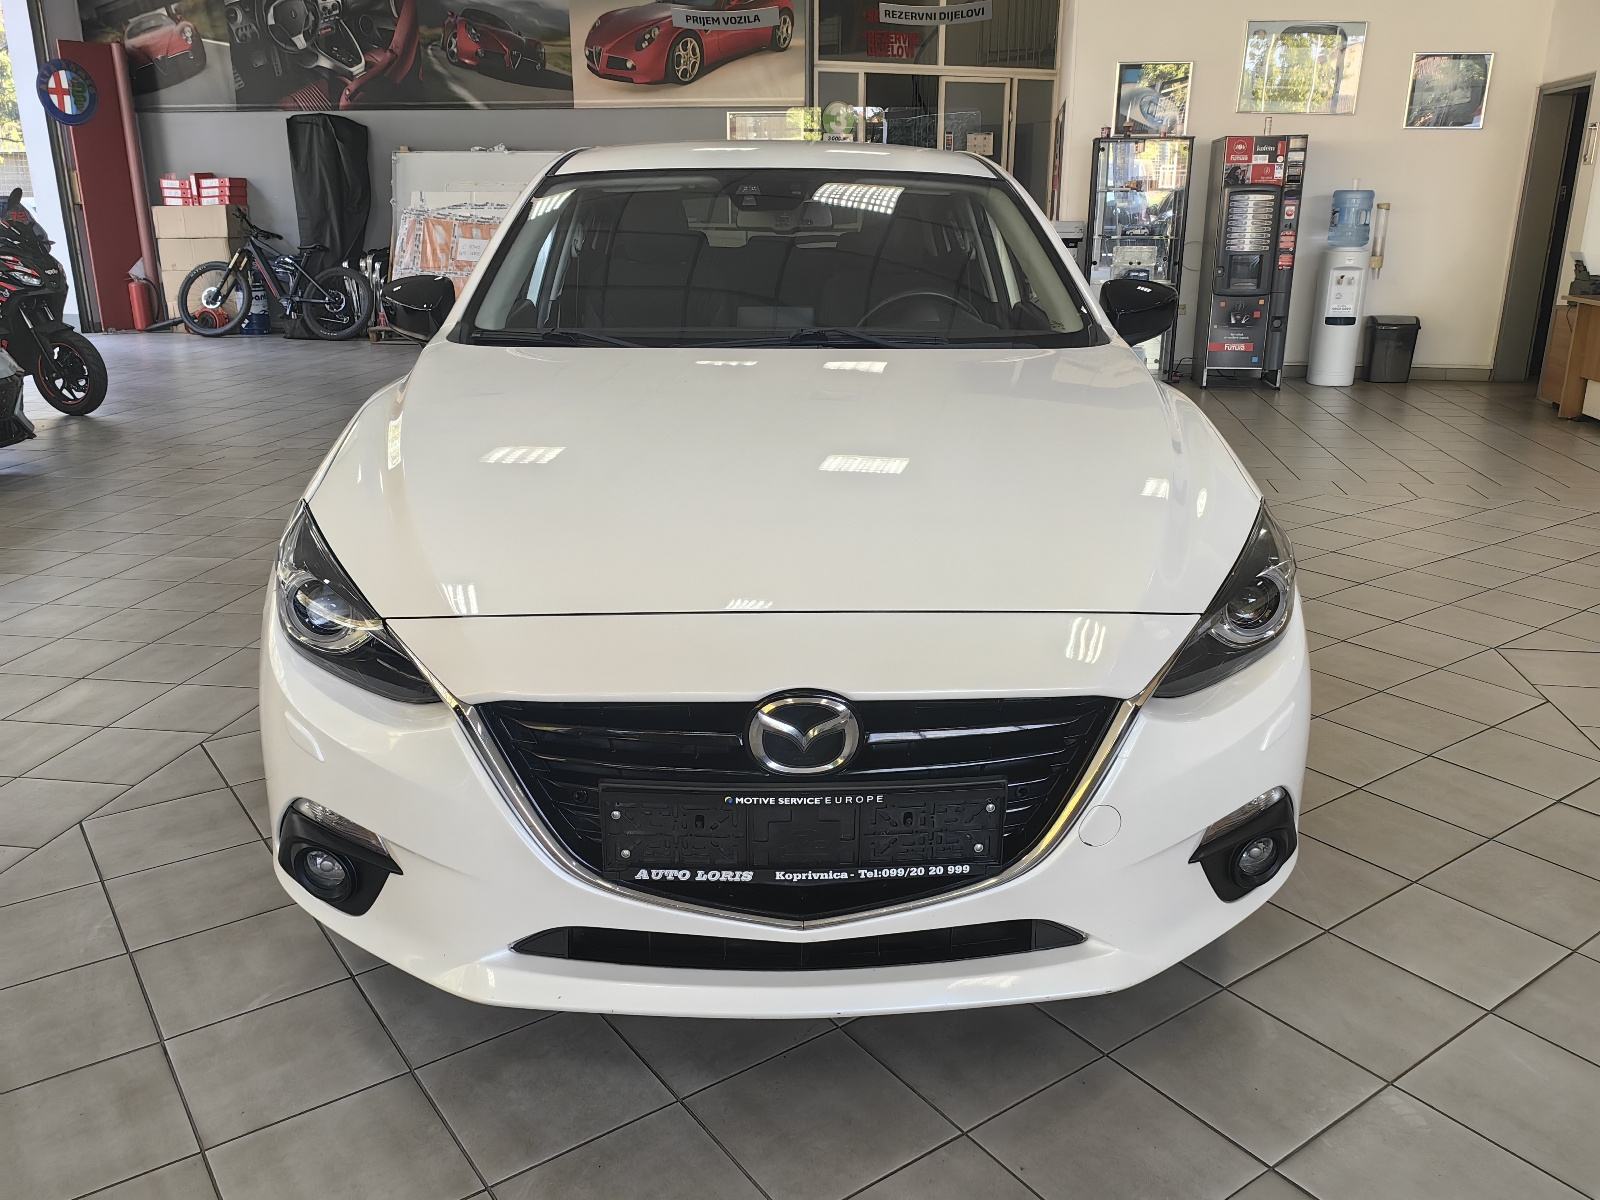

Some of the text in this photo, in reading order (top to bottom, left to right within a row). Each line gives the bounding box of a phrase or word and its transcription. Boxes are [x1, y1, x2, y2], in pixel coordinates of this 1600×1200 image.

[686, 15, 761, 26] PRIJEM VOZILA
[885, 7, 985, 21] REZERVNI DIJELOVI
[735, 795, 884, 805] MOTIVE SERVICE EUROPE
[634, 868, 754, 882] AUTO LORIS
[775, 870, 848, 882] Koprivnica
[858, 867, 925, 878] Tel:099/20
[929, 866, 944, 875] 20
[947, 865, 970, 874] 999
